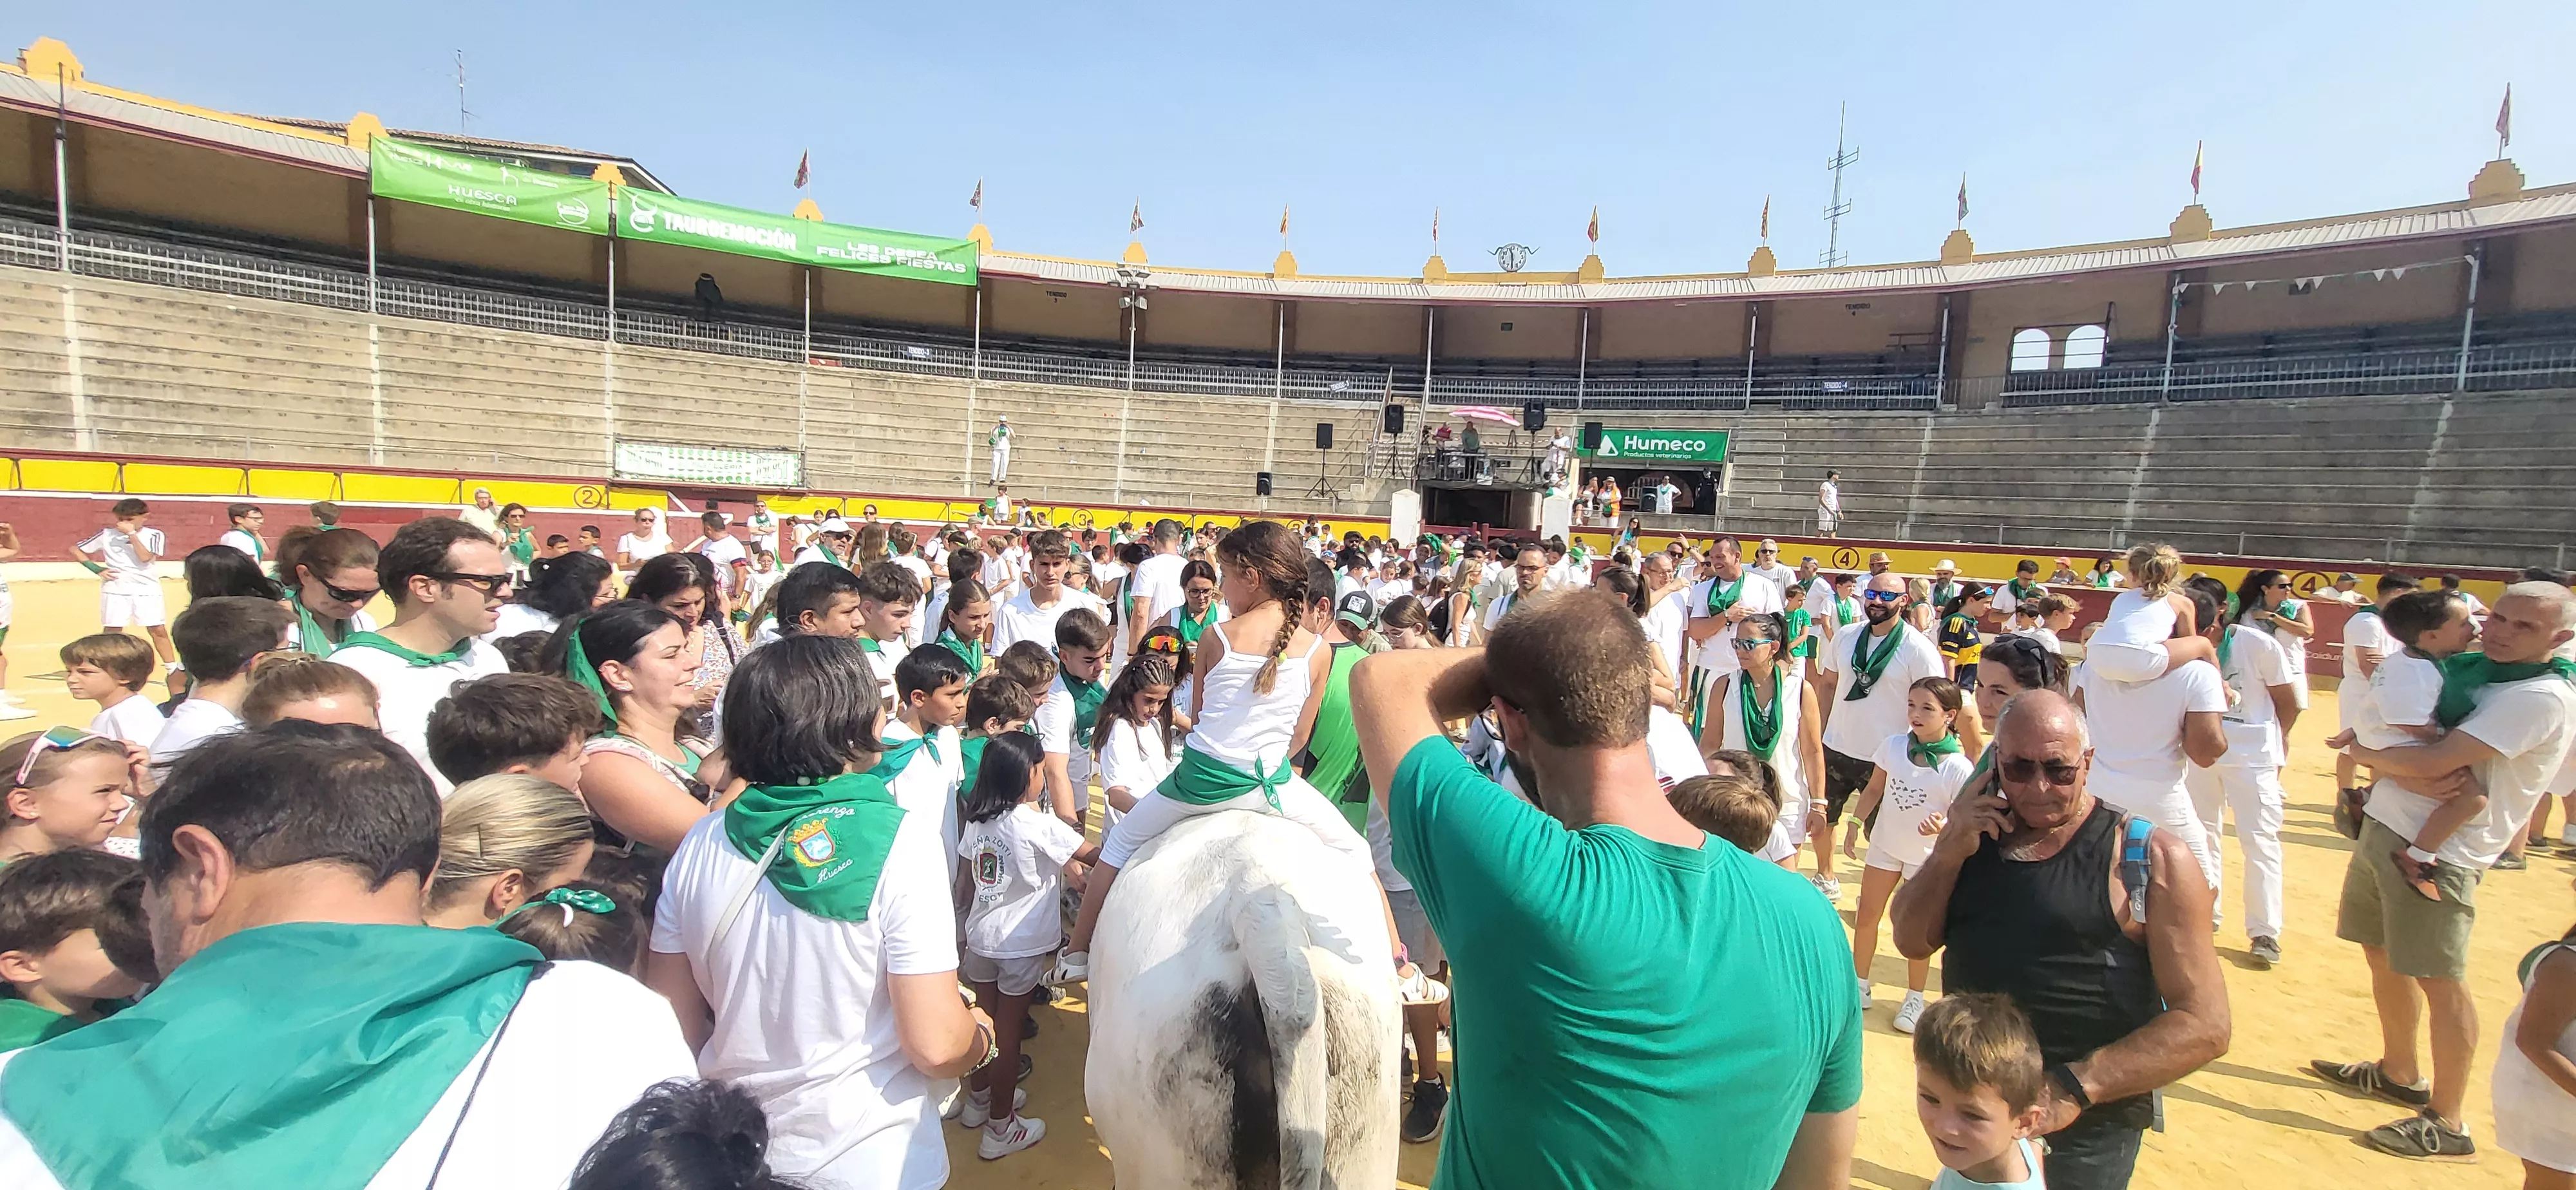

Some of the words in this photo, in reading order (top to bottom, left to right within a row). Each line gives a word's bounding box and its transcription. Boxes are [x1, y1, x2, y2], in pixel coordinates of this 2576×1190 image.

[448, 184, 518, 207] HUESCA
[663, 211, 797, 251] TAUROEMOCIÓN
[817, 245, 892, 264] FELICES
[896, 256, 967, 274] FIESTAS
[847, 241, 880, 254] LES
[884, 246, 939, 261] DESEA
[1624, 435, 1706, 452] Humeco
[582, 489, 593, 504] 2
[1079, 514, 1086, 526] 3
[1839, 551, 1850, 567] 4
[2300, 576, 2316, 594] 4
[971, 835, 990, 851] EÑA
[817, 858, 853, 883] Huesca
